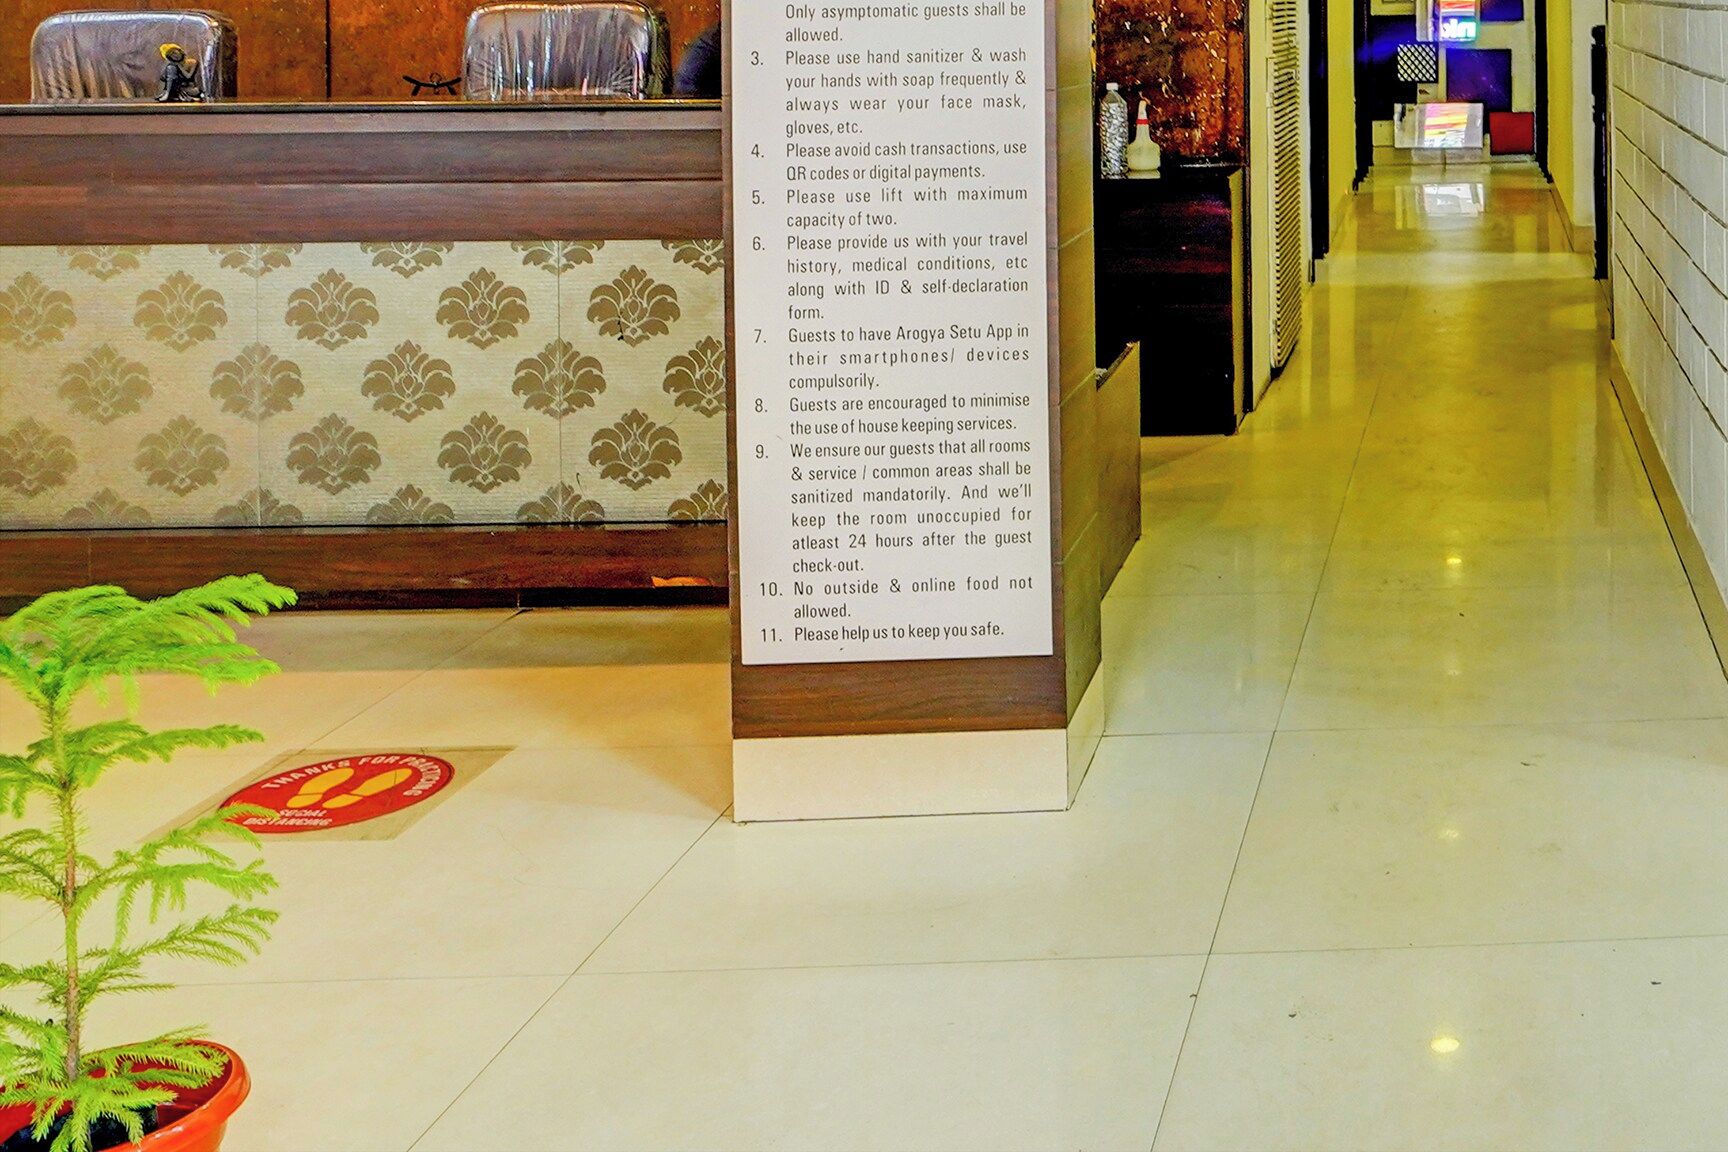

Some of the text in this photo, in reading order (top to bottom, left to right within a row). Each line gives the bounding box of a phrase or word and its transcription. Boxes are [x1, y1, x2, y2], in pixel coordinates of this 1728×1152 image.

[786, 1, 1026, 22] Only asymptomatic guests shall be
[785, 26, 843, 43] allowed.
[751, 47, 1026, 66] 3. Please use hand sanitizer & wash
[786, 70, 1027, 92] your hands with soap frequently &
[786, 93, 1026, 114] always wear your face mask,
[786, 120, 862, 139] gloves, etc.
[751, 140, 1027, 158] 4. Please avoid cash transactions, use
[752, 186, 1027, 205] 5. Please use lift with maximum
[787, 211, 897, 230] capacity of two.
[752, 231, 1028, 253] 6. Please provide us with your travel
[787, 255, 1028, 276] history, medical conditions, etc
[788, 304, 824, 320] form.
[754, 323, 1029, 344] 7. Guests to have Arogya Setu App in
[789, 346, 1029, 367] their smartphones/ devices
[789, 372, 879, 392] compulsorily.
[754, 392, 1030, 413] 8. Guests are encouraged to minimise
[755, 437, 1031, 459] 9. We ensure our guests that all rooms
[791, 483, 1031, 504] sanitized mandatorily. And we'll
[760, 575, 1033, 597] 10. No outside & online food not
[794, 602, 851, 619] allowed.
[761, 621, 1004, 643] 11. Please help us to keep you safe.
[261, 759, 350, 789] THANKS
[358, 755, 400, 766] FOR
[242, 817, 333, 826] DISTANCING
